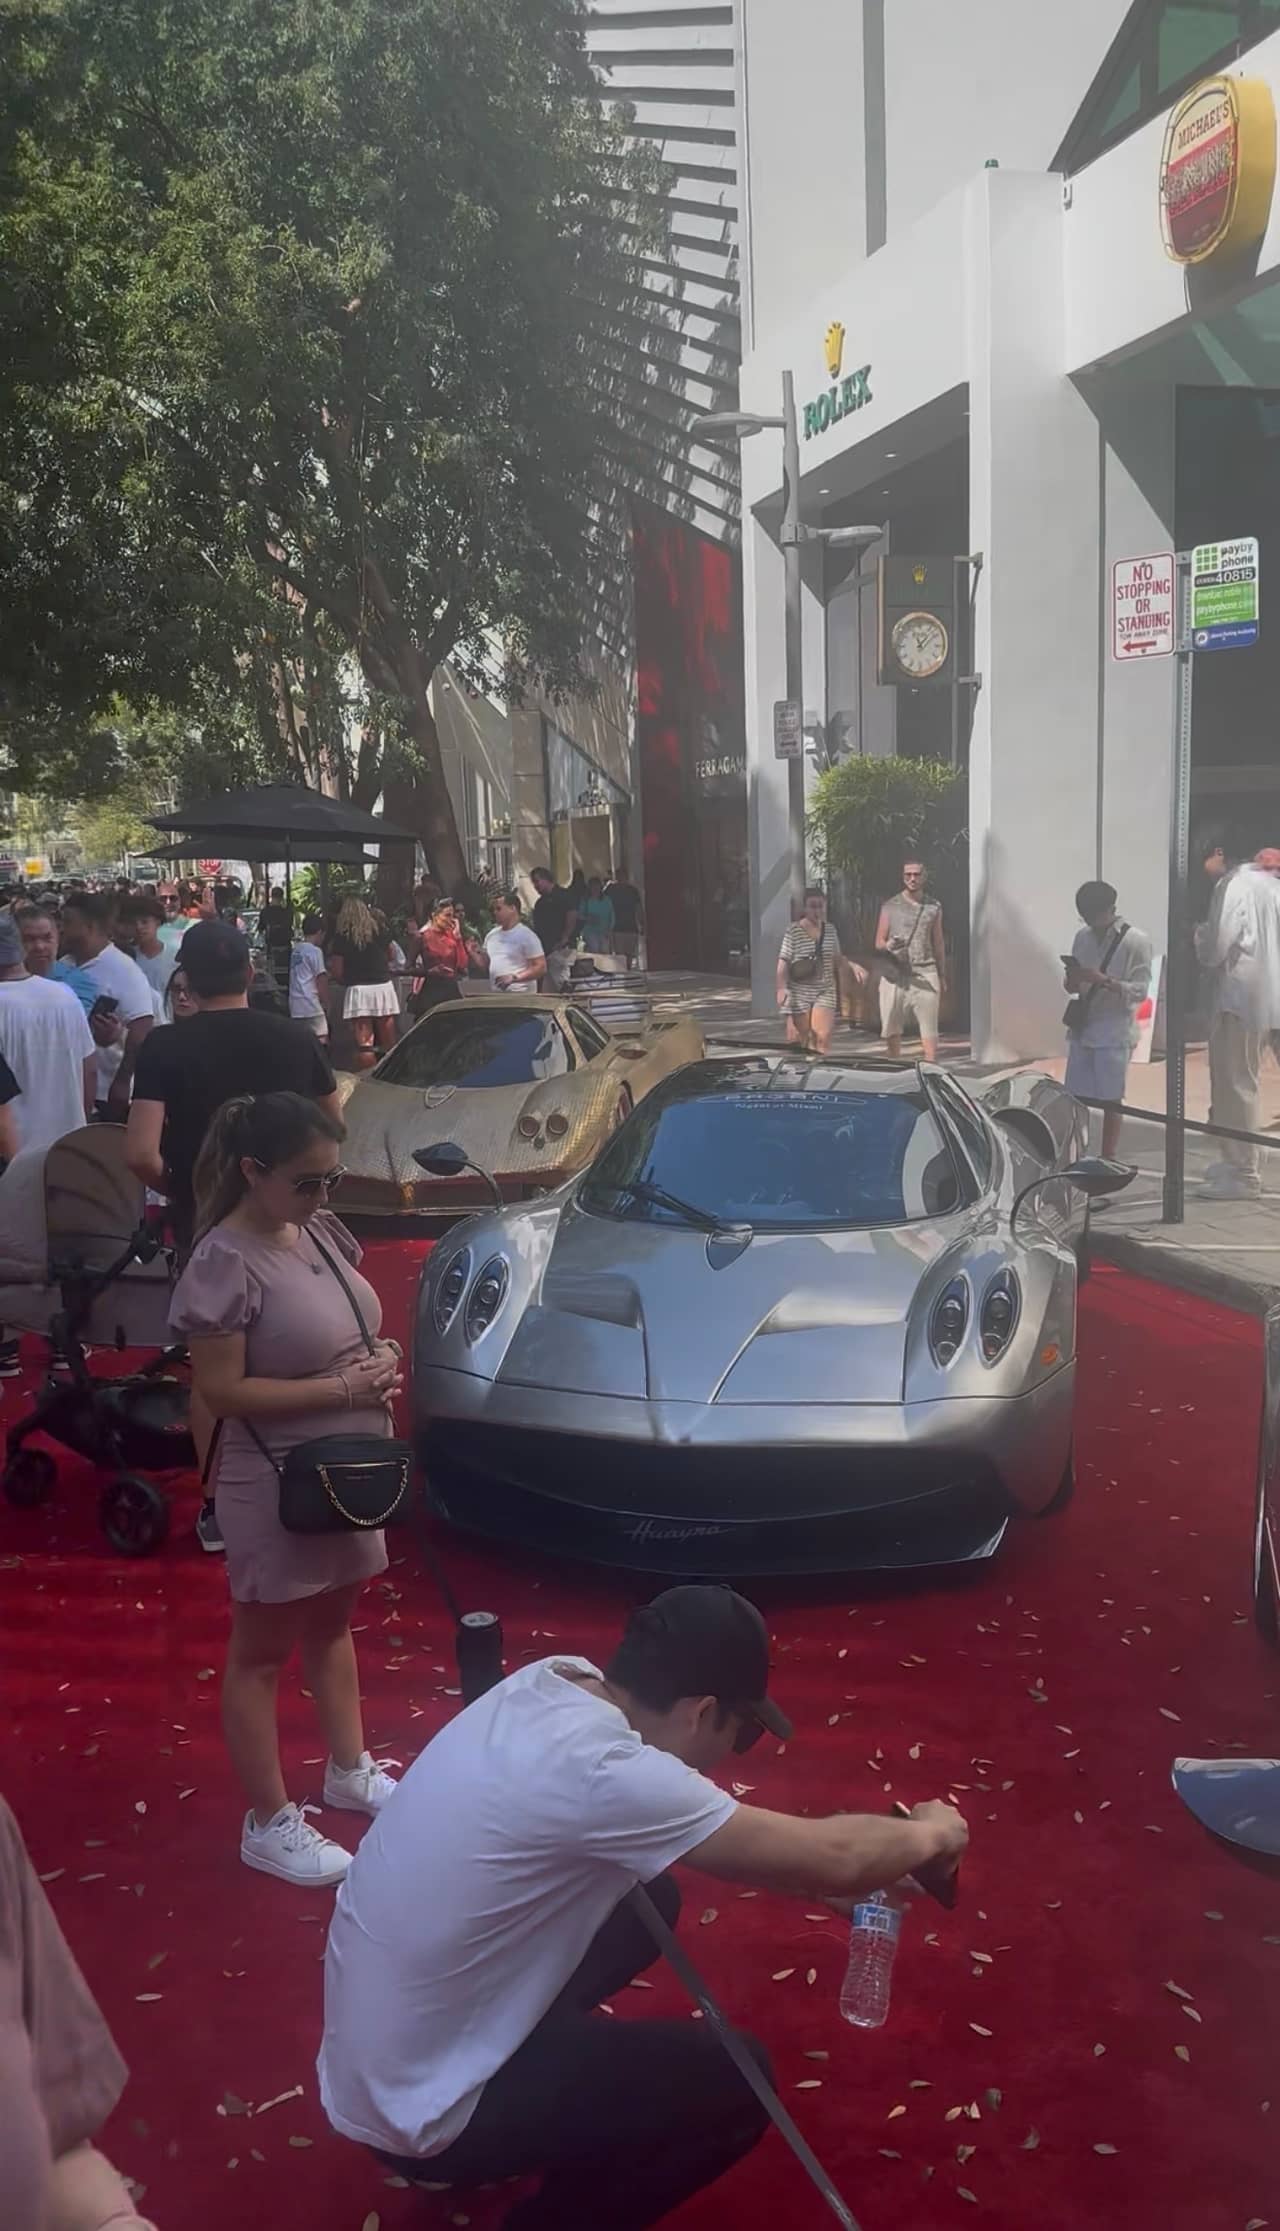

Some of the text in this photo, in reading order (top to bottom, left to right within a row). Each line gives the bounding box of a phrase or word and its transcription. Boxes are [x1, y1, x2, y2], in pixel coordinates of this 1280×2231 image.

[1177, 99, 1229, 150] MICHAEL'S
[803, 364, 873, 441] ROLEX
[1221, 555, 1254, 569] phone
[1133, 563, 1153, 582] NO
[1215, 566, 1254, 584] 40815
[1117, 578, 1170, 600] STOPPING
[1135, 598, 1150, 614] OR
[1118, 611, 1170, 632] STANDING
